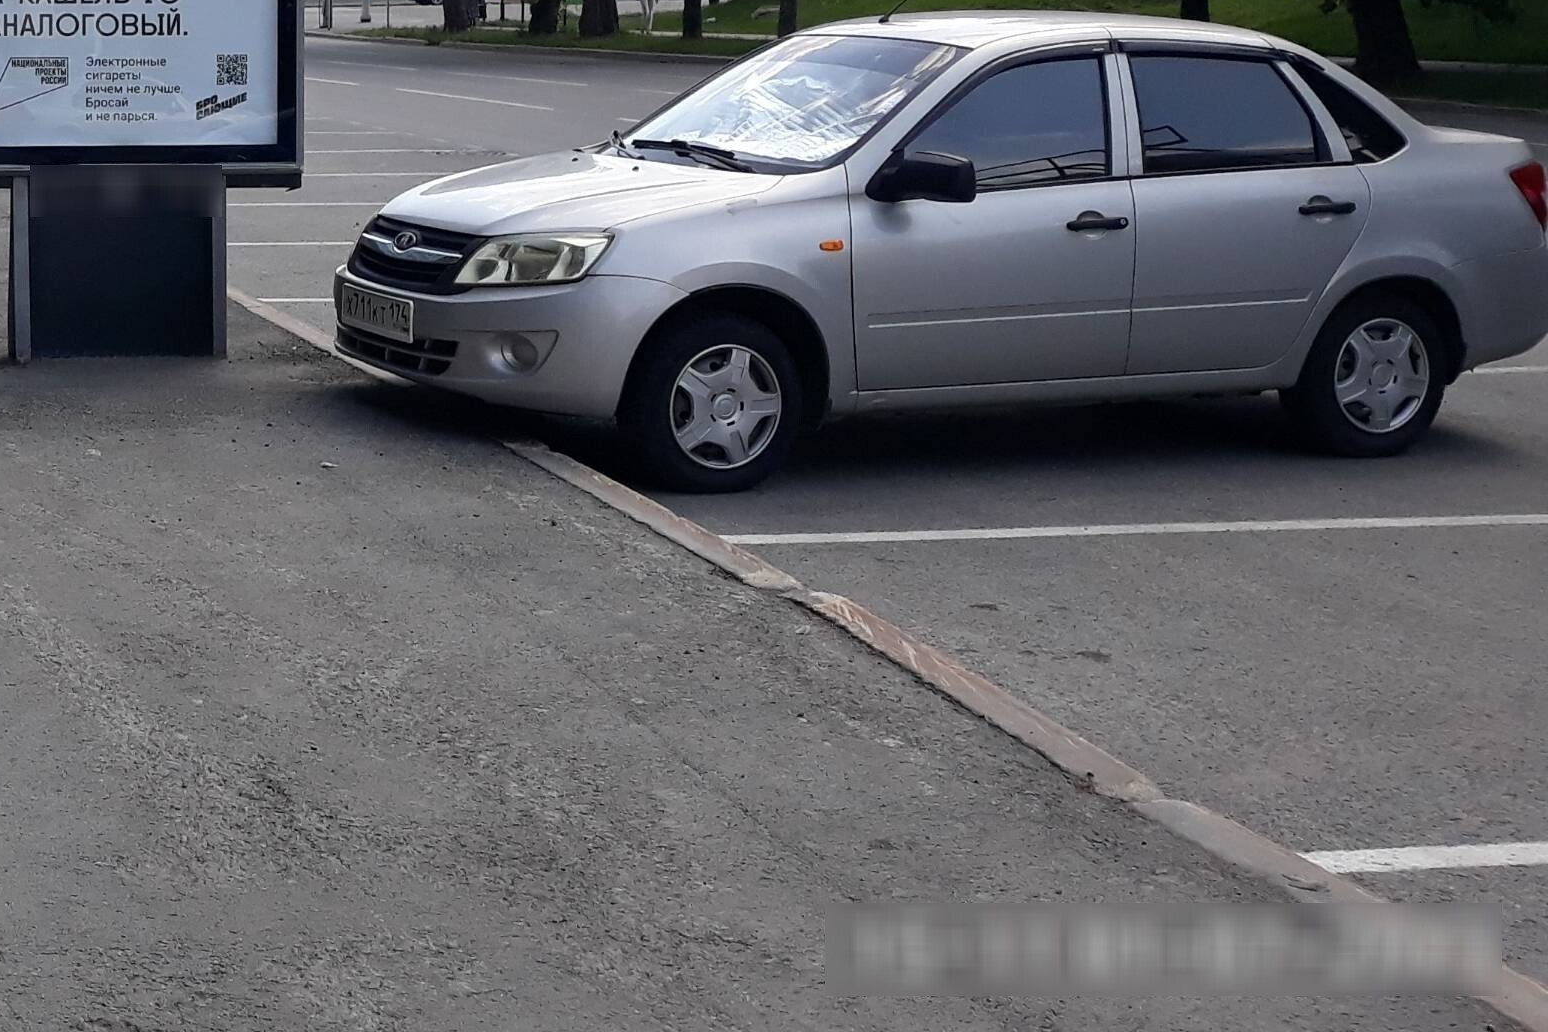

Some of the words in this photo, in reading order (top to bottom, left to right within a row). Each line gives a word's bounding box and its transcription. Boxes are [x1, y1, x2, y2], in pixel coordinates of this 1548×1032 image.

[11, 59, 66, 68] НАЦИОНАЛЬНЫЕ
[85, 56, 167, 68] Электронные
[35, 68, 66, 76] ПРОЕКТЫ
[85, 72, 141, 82] сигареты
[40, 76, 66, 84] РОССИИ
[85, 85, 123, 94] ничем
[126, 85, 140, 94] не
[85, 97, 129, 109] Бросай
[85, 113, 92, 121] и
[96, 113, 110, 121] не
[113, 113, 158, 123] парься.
[389, 301, 408, 324] 174
